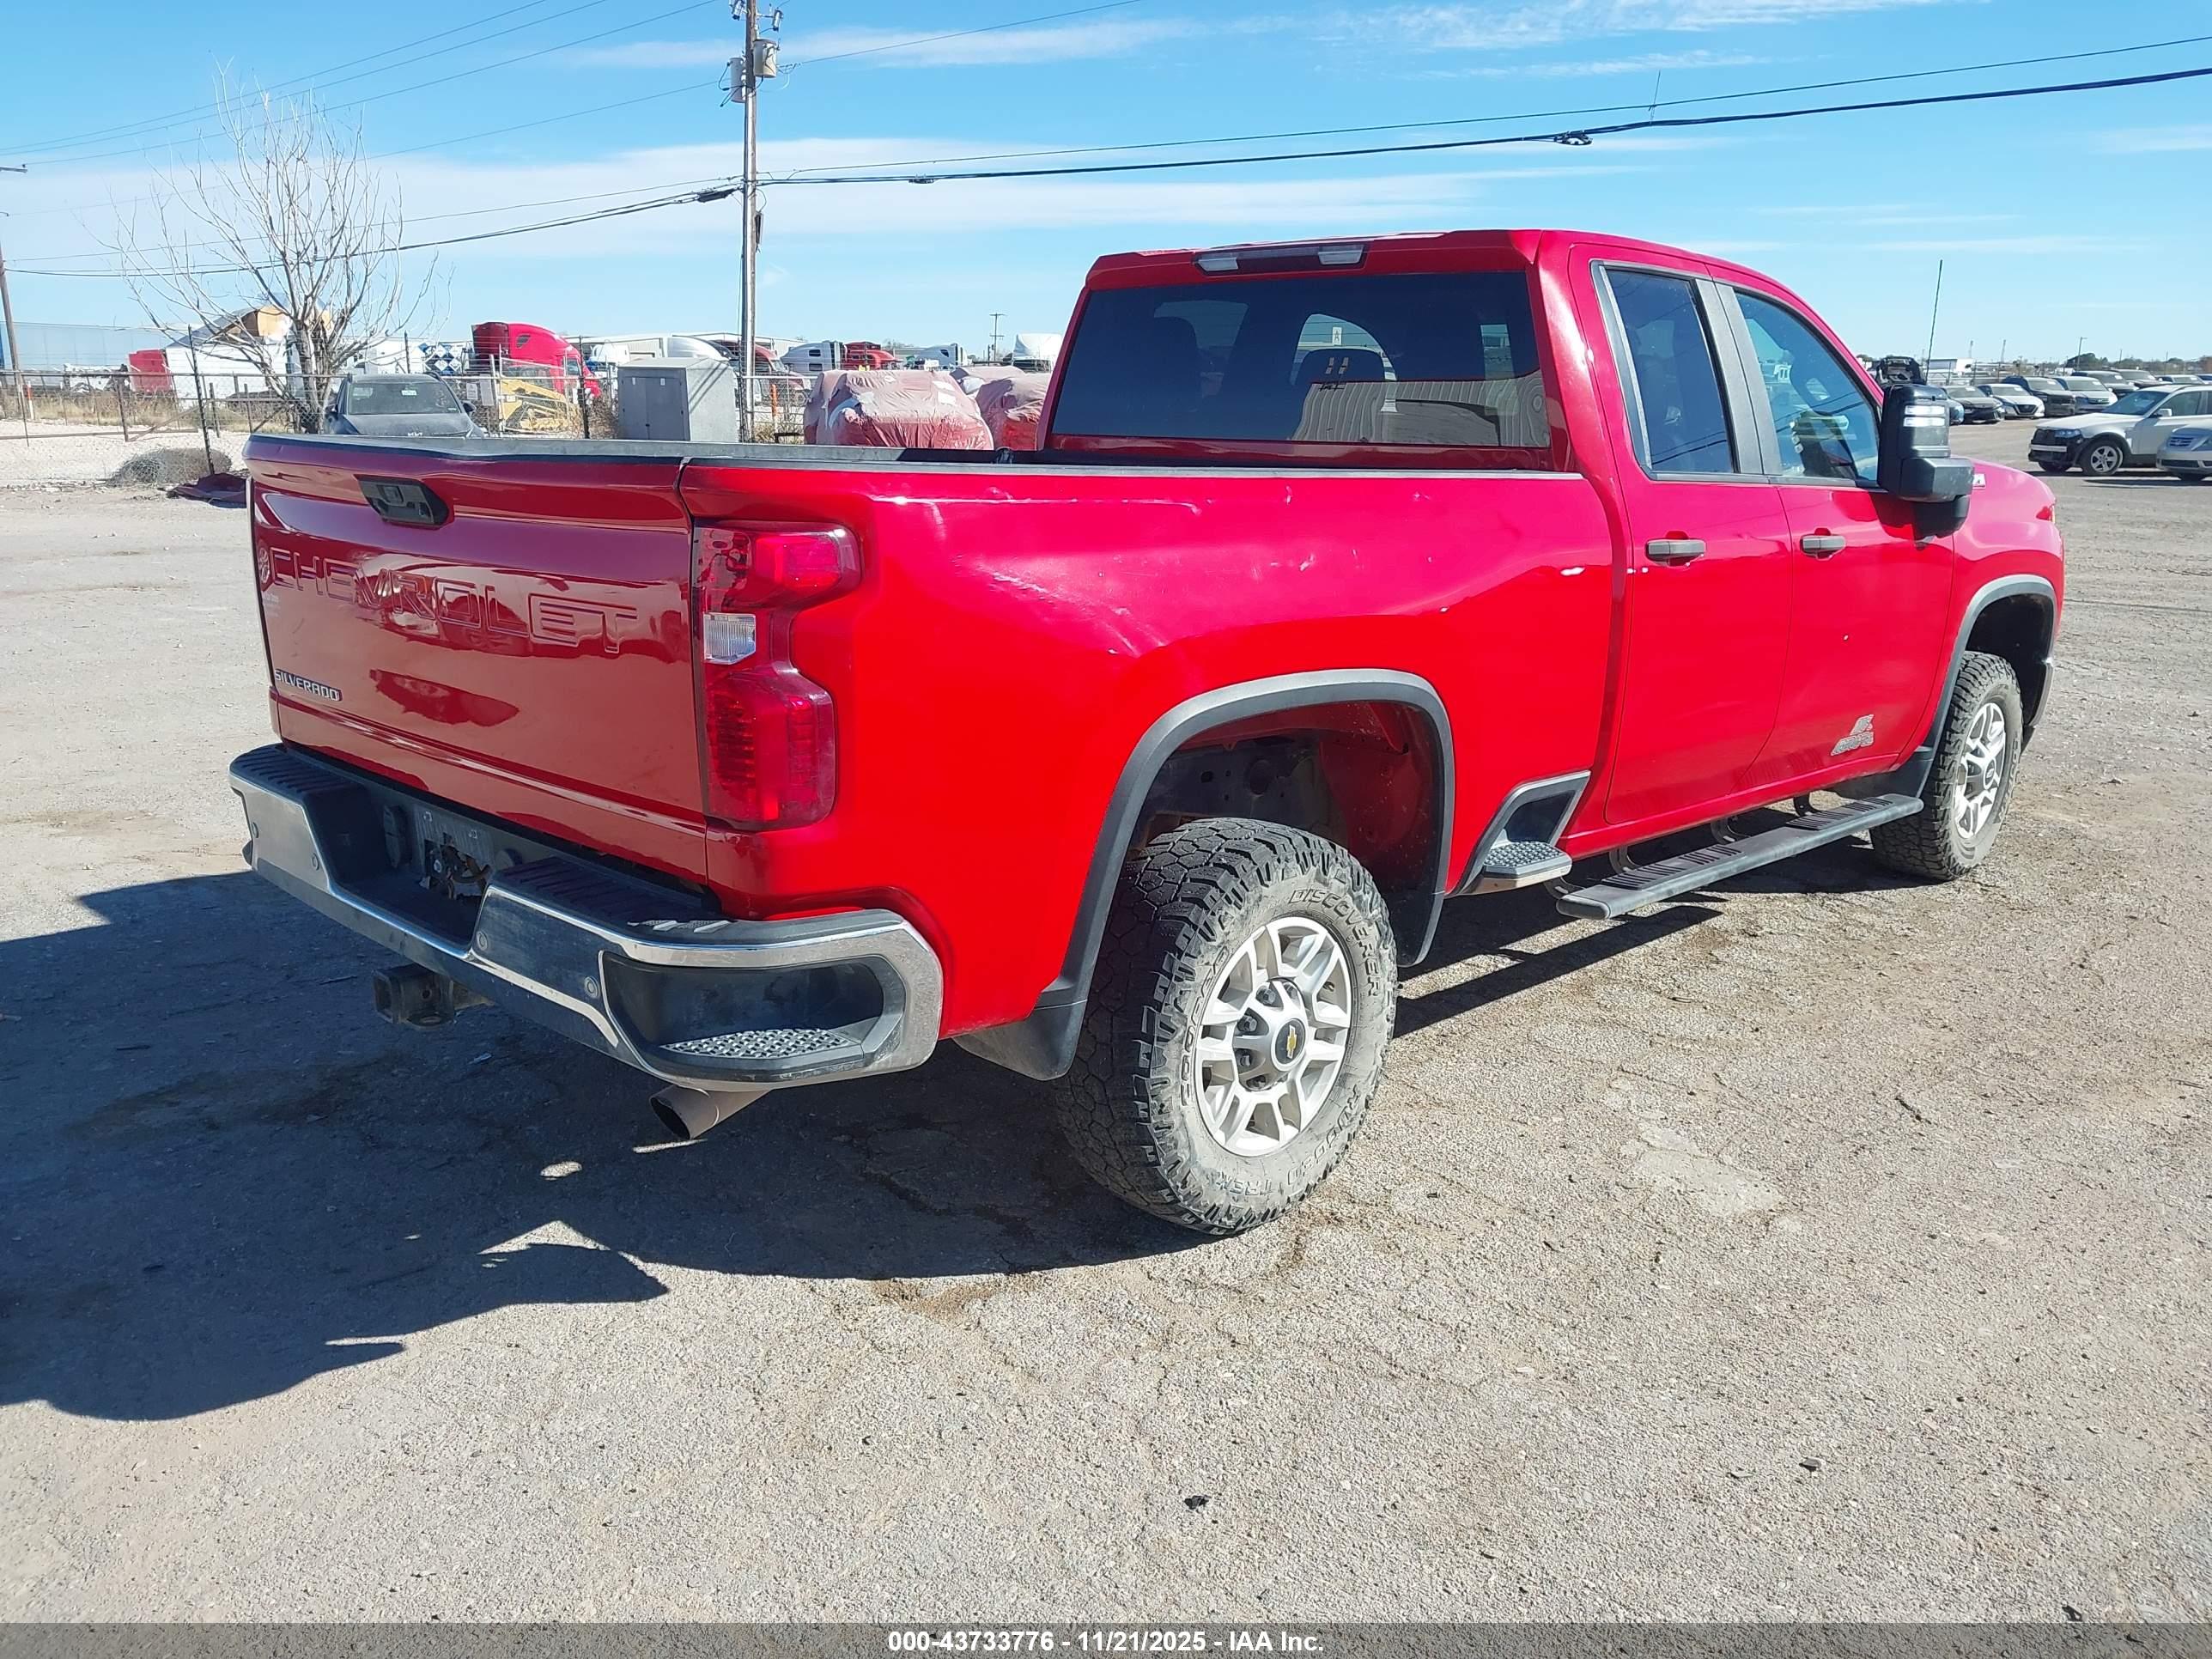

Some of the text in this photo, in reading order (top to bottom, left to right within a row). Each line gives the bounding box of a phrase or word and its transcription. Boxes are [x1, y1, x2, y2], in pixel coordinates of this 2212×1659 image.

[270, 546, 637, 653] CHEVROLET
[275, 670, 340, 701] SILVERADO
[1288, 888, 1380, 996] DISCOVERER
[1181, 945, 1230, 1106] COOPER
